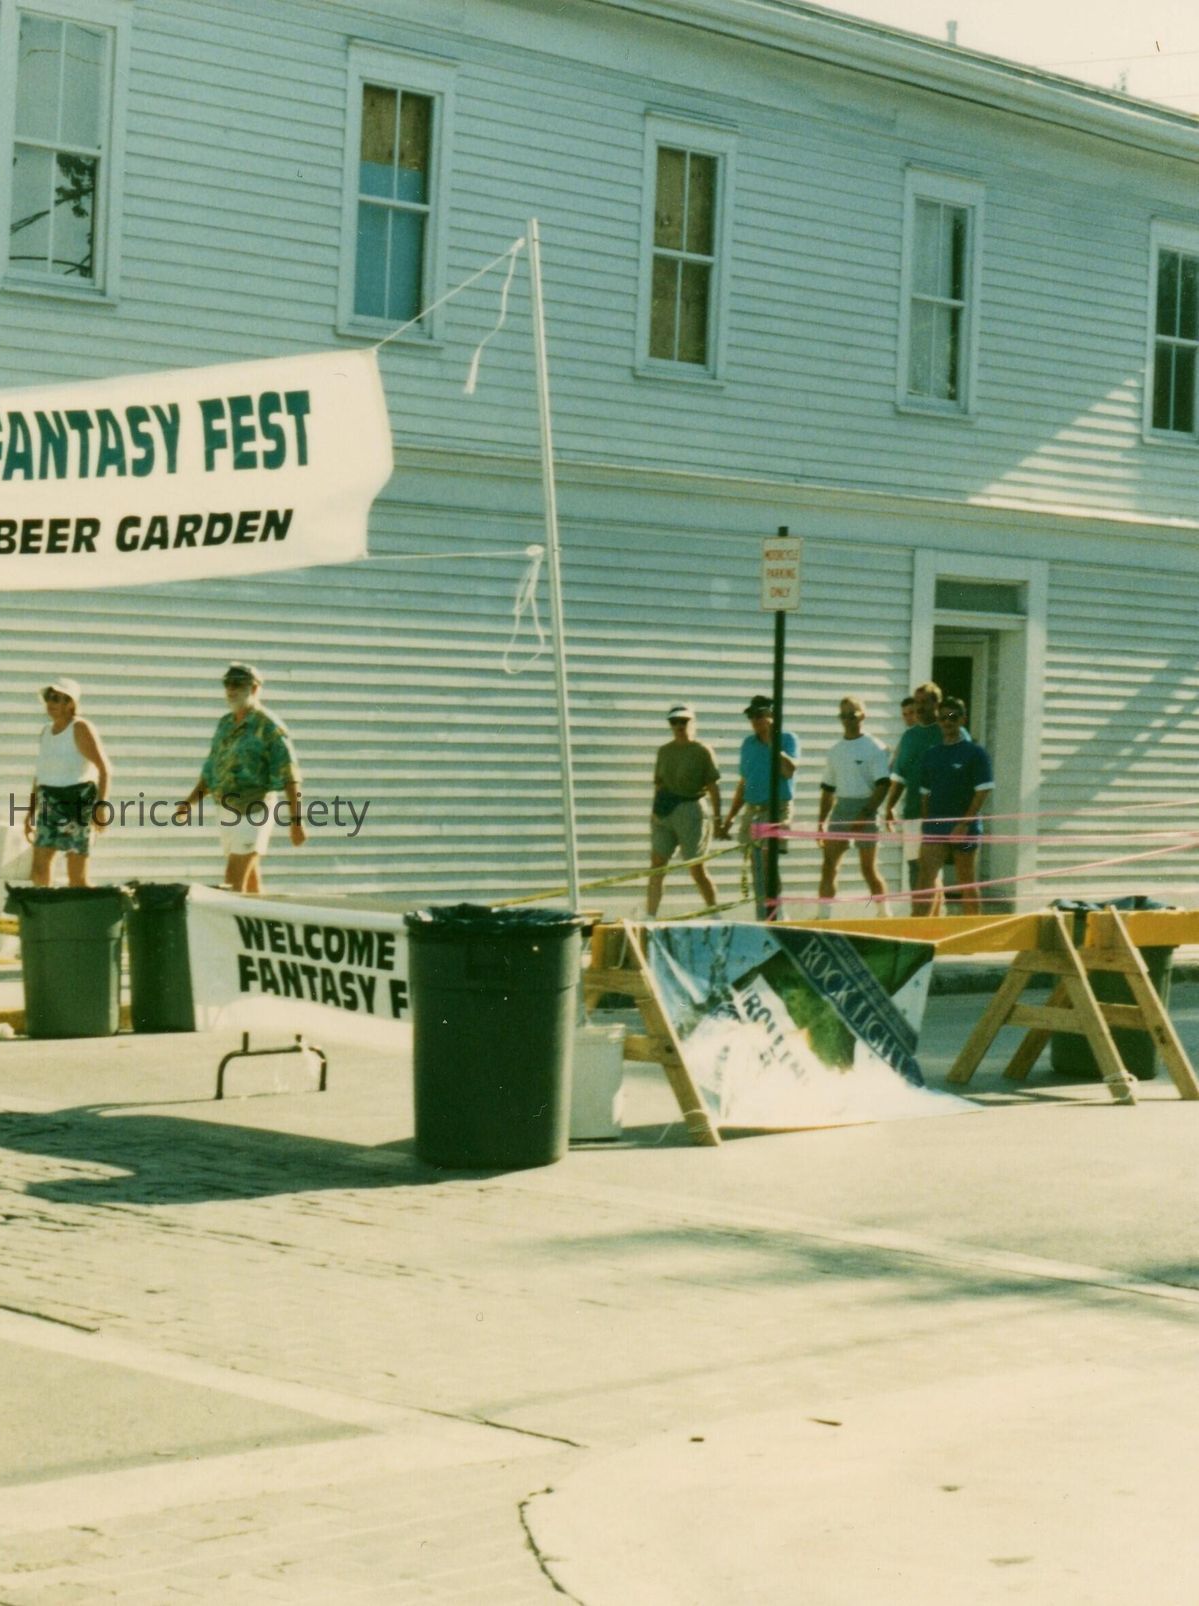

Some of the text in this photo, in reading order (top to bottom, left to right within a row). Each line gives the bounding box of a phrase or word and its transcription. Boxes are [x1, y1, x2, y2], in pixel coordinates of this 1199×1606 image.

[199, 390, 311, 472] FEST
[115, 508, 294, 553] GARDEN
[234, 914, 397, 971] WELCOME
[800, 937, 857, 1008] ROCK
[238, 954, 377, 1015] FANTASY
